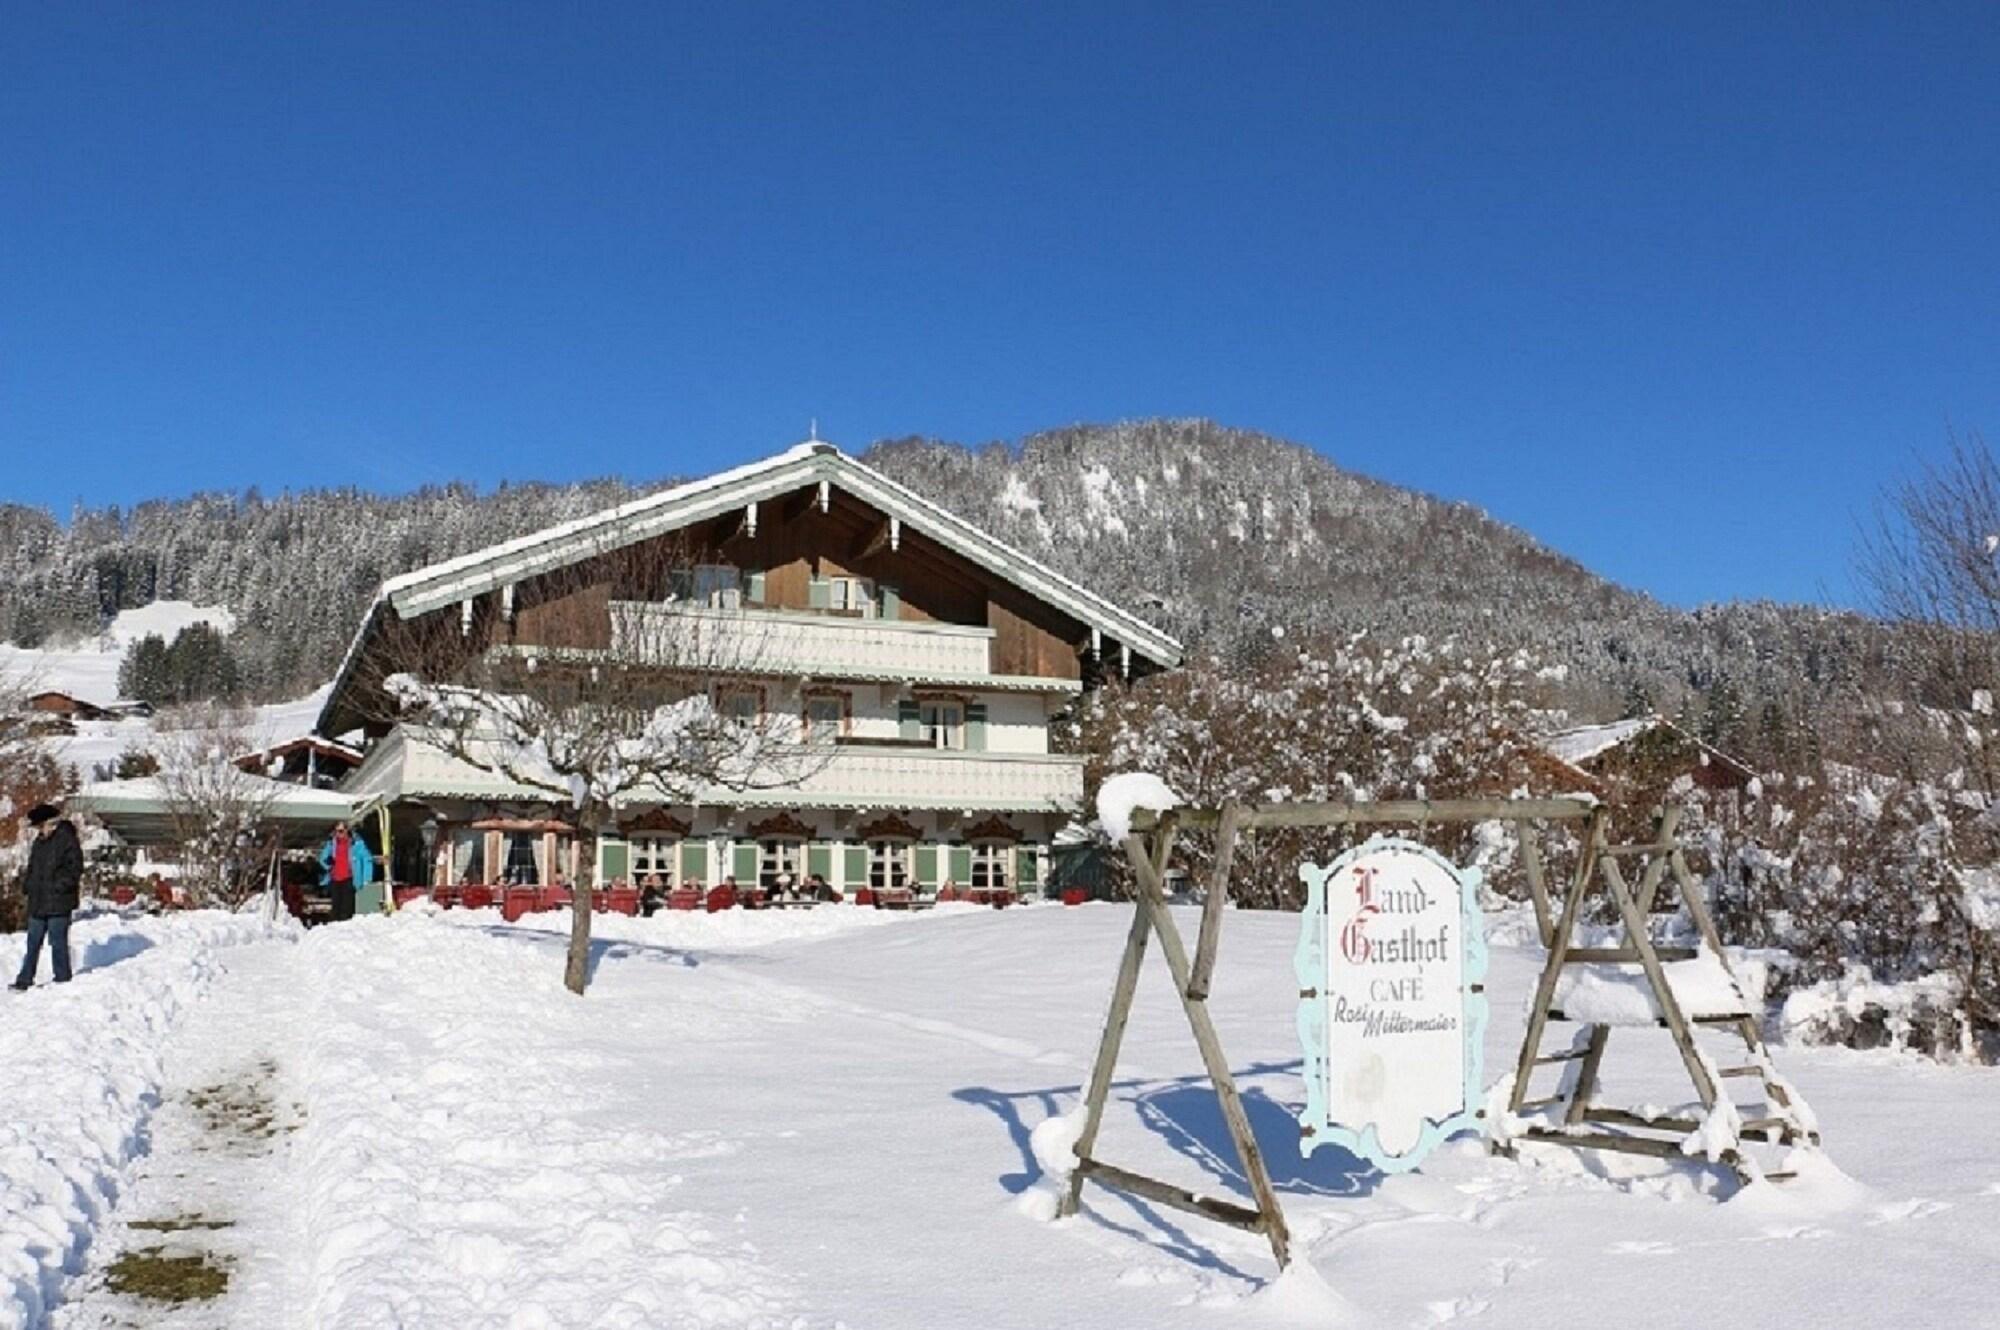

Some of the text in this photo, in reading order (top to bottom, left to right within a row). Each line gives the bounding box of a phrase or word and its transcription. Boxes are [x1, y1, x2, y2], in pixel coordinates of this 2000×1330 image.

[1352, 867, 1436, 914] Land-
[1341, 912, 1449, 974] Gasthof
[1334, 996, 1457, 1038] Rosi Mittermaier
